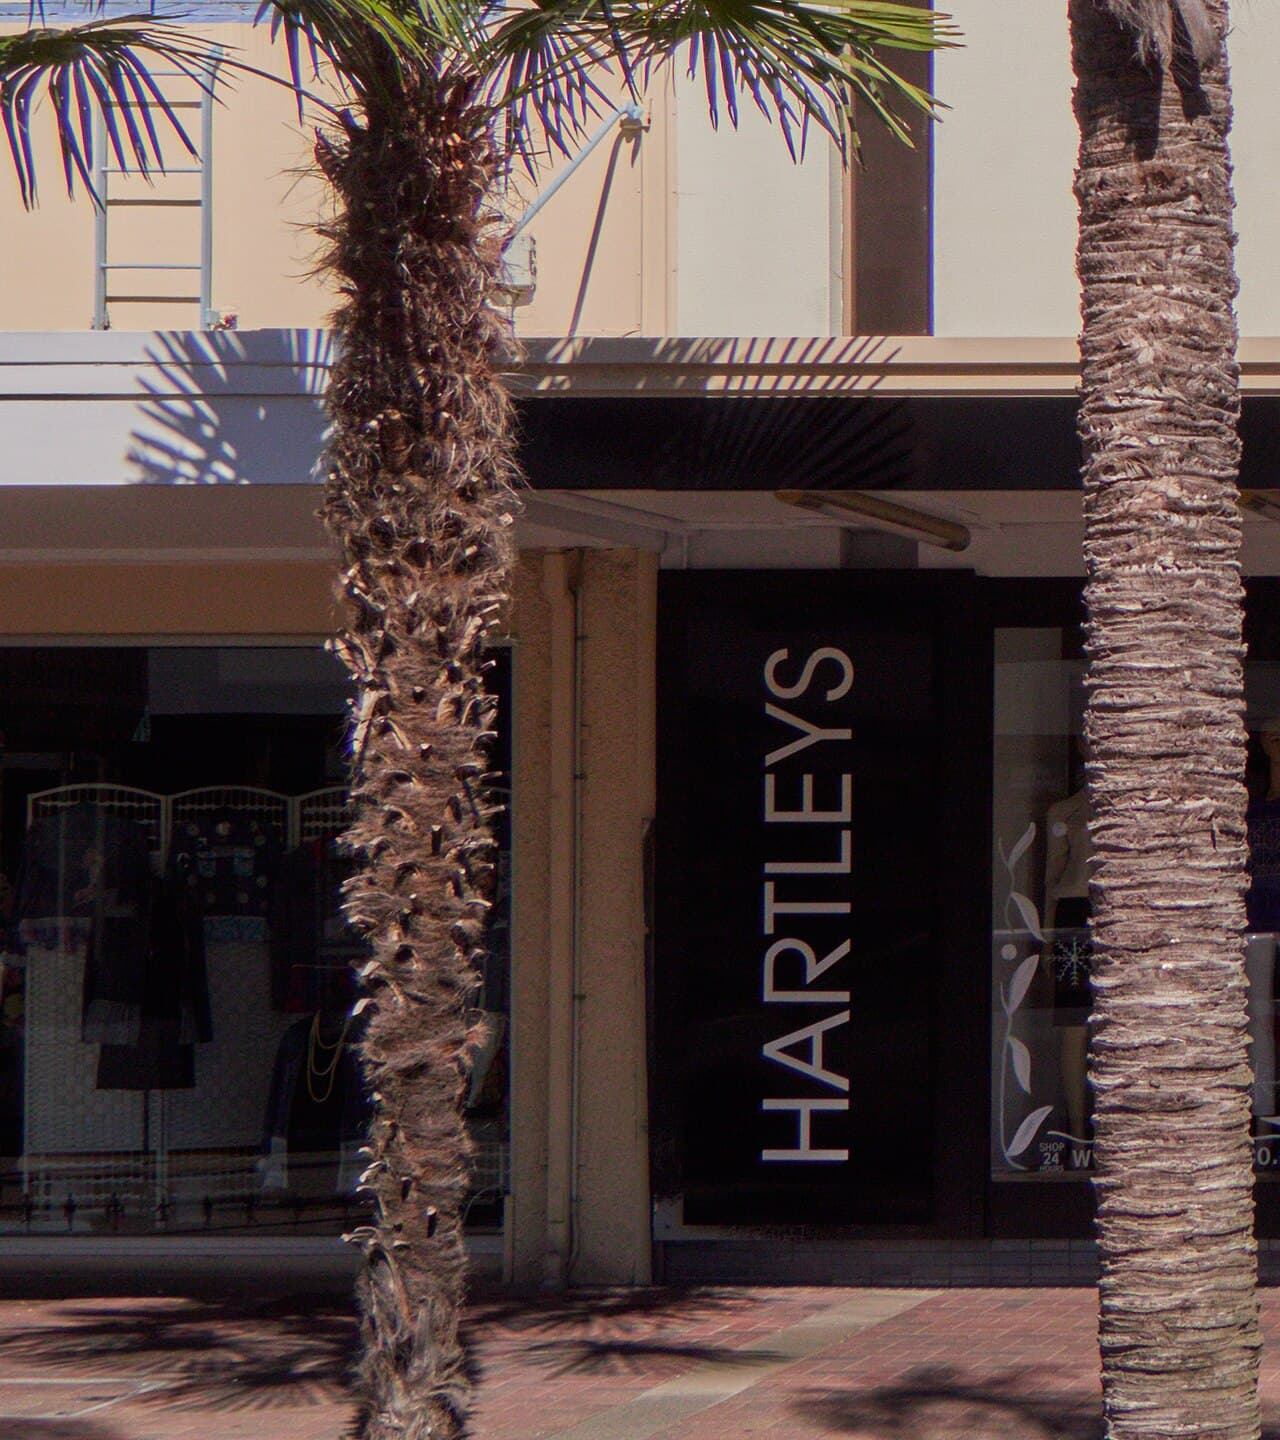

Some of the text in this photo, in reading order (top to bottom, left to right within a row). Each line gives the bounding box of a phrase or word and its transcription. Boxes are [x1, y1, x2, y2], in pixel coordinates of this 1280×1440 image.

[761, 646, 855, 1161] HARTLEYS
[1040, 1142, 1065, 1152] SHOP
[1043, 1152, 1060, 1165] 24
